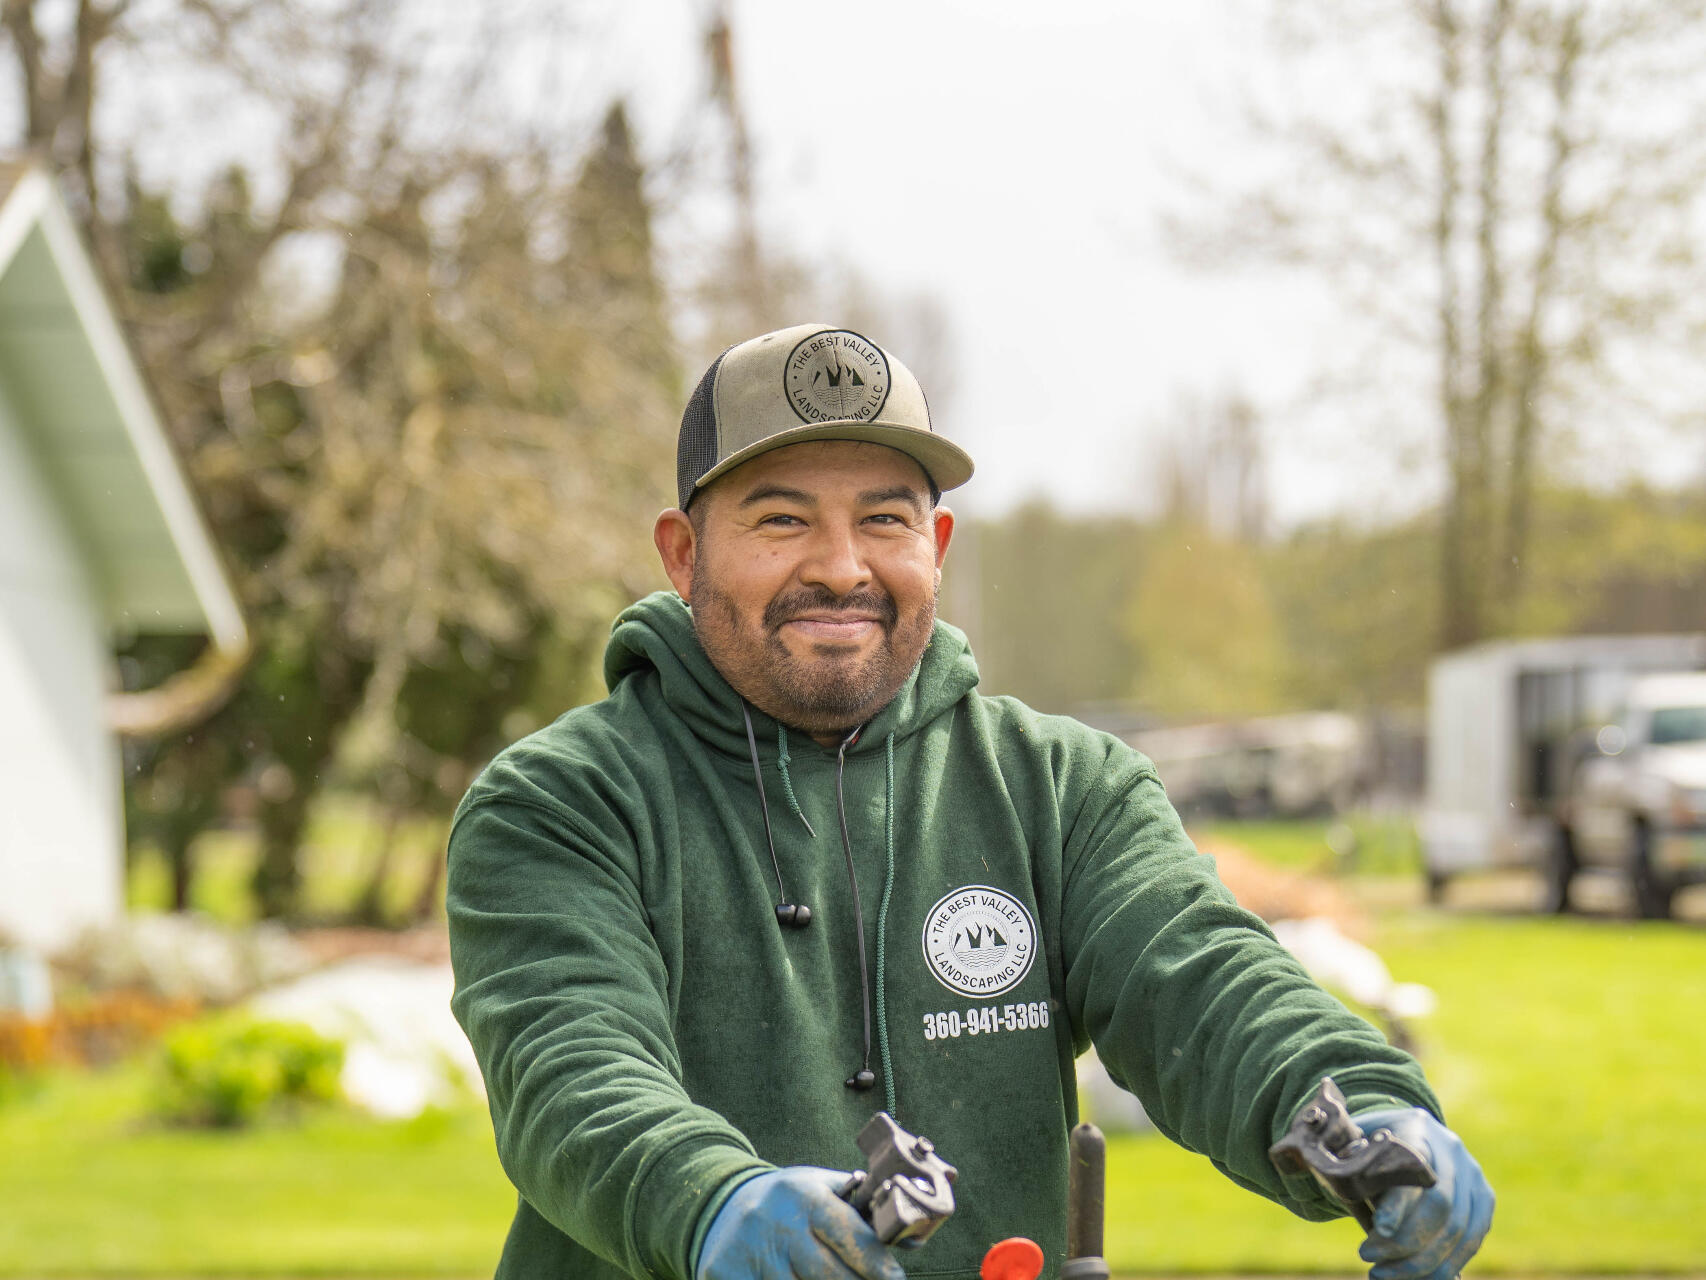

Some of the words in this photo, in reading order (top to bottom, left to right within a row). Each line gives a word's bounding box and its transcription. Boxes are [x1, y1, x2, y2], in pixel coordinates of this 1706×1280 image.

[793, 348, 812, 370] THE
[810, 336, 840, 352] BEST
[843, 337, 880, 367] VALLEY
[793, 389, 871, 422] LANDSCING
[868, 385, 883, 407] LLC
[933, 912, 951, 934] THE
[948, 895, 977, 914] BEST
[981, 896, 1022, 925] VALLEY
[934, 952, 1016, 988] LANDSCAPING
[1012, 943, 1027, 967] LLC
[923, 1001, 1049, 1040] 360-941-5366
